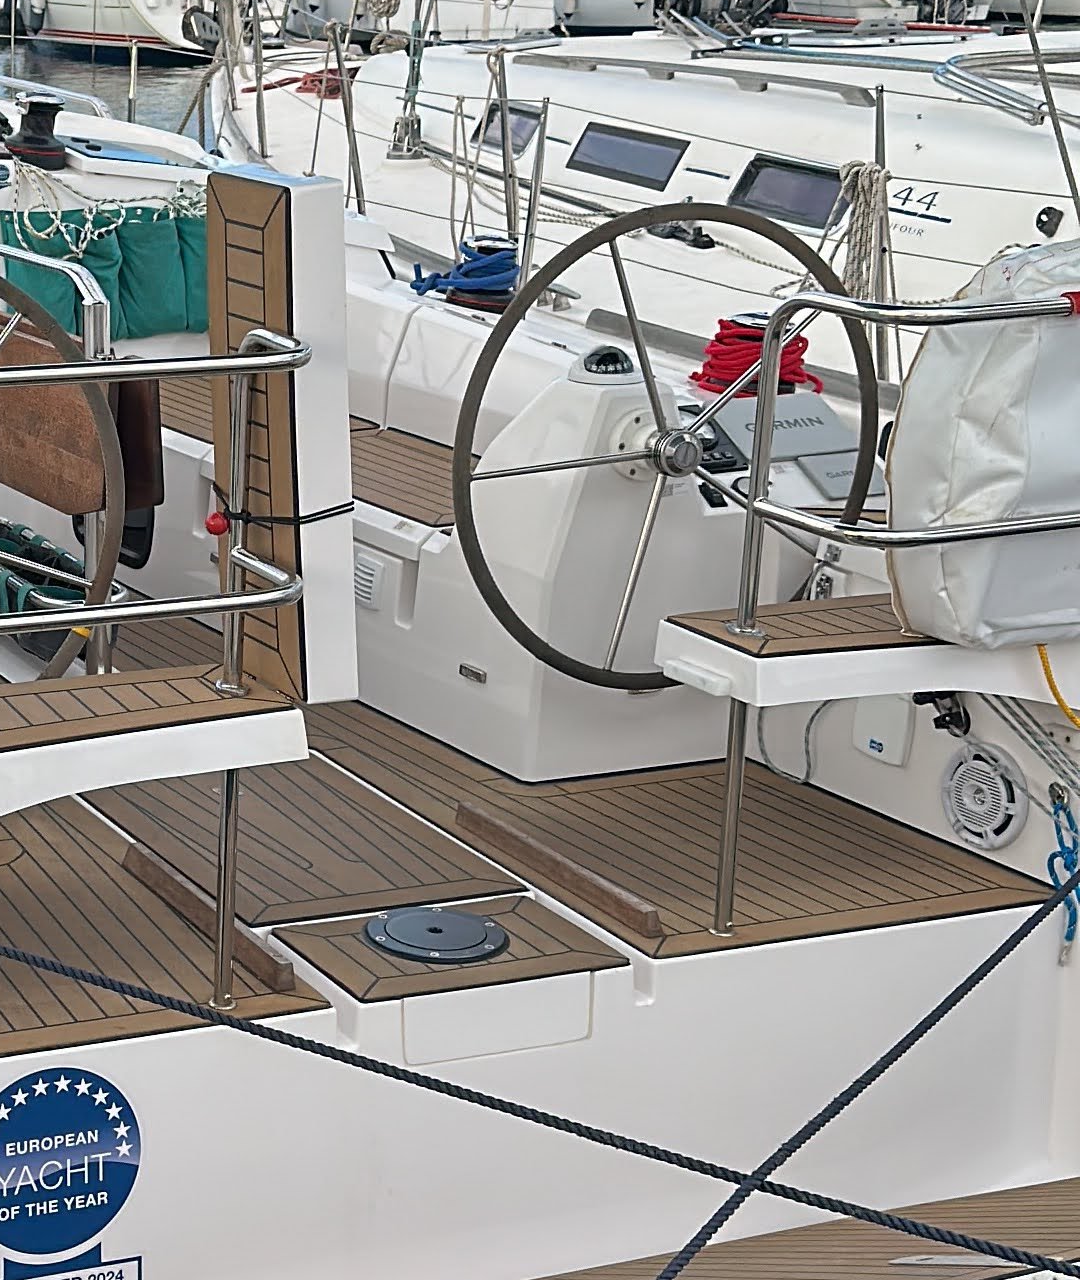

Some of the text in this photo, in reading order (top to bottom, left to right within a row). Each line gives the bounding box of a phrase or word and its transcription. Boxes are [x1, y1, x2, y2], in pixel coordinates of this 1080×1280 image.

[892, 186, 939, 211] 44
[5, 1129, 99, 1157] EUROPEAN
[25, 1200, 59, 1218] THE
[63, 1191, 108, 1211] YEAR
